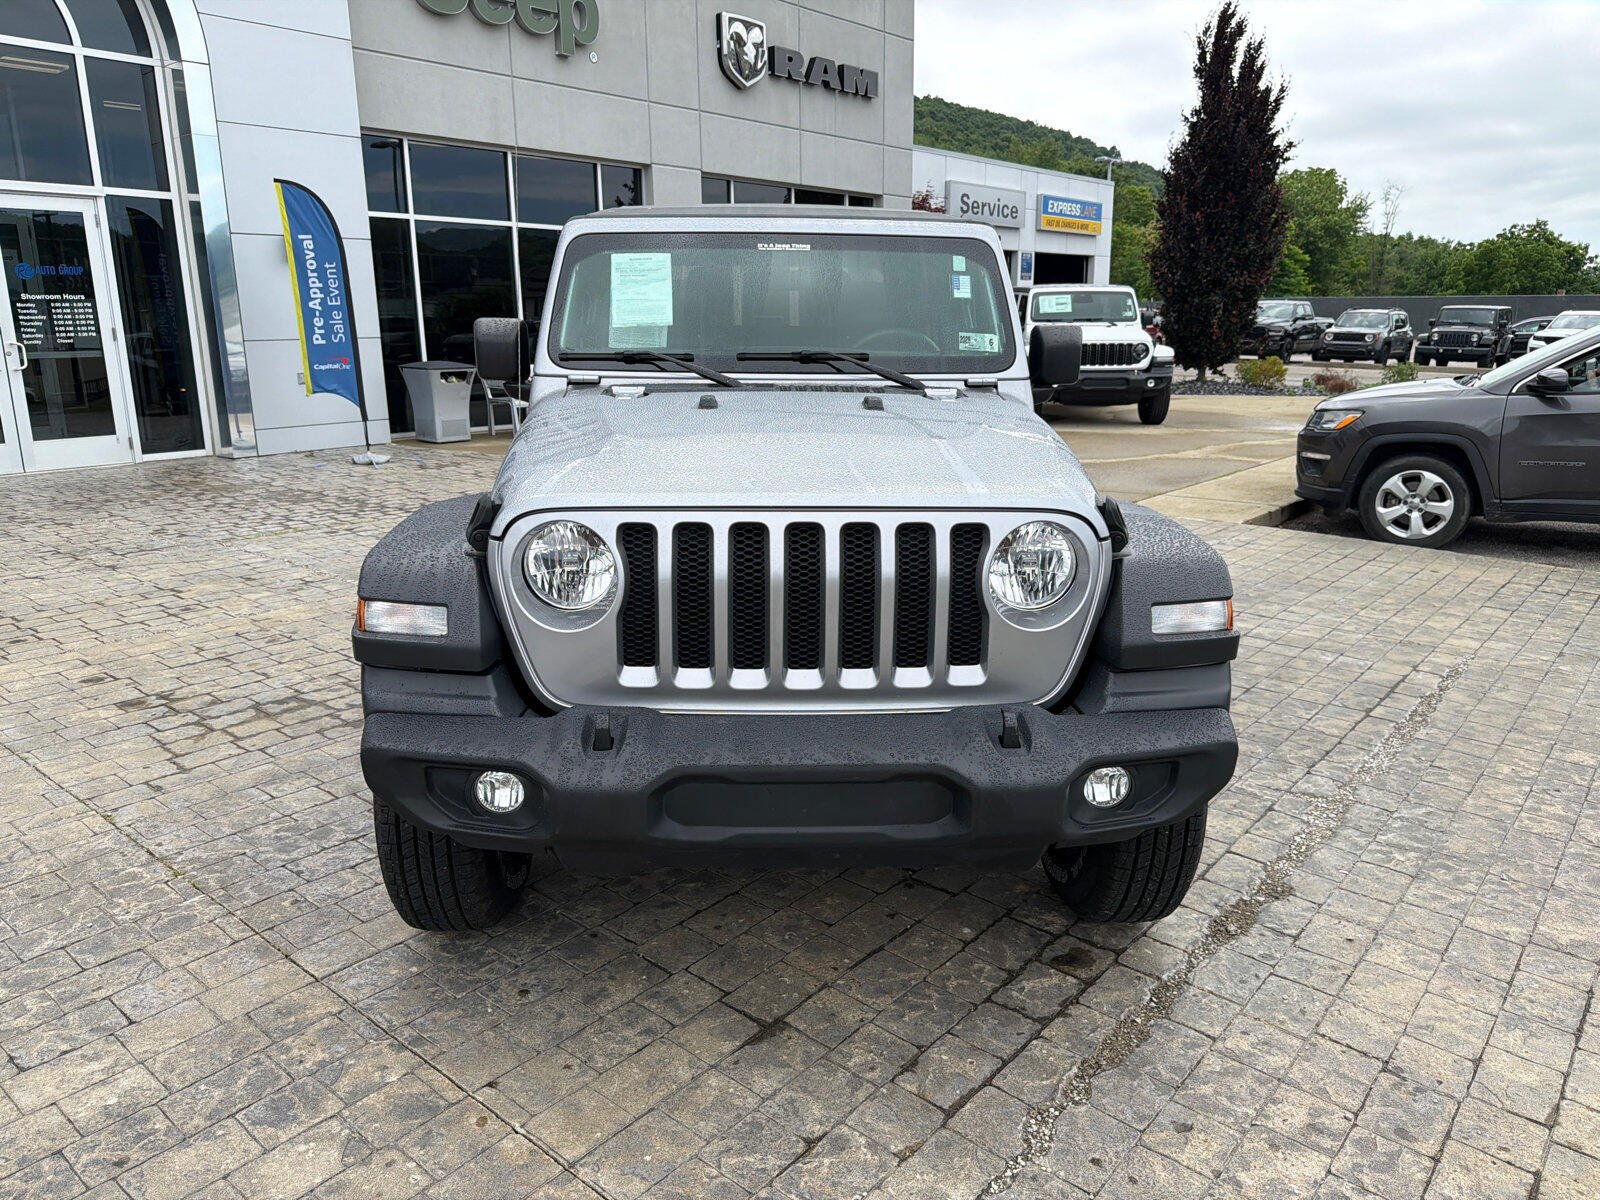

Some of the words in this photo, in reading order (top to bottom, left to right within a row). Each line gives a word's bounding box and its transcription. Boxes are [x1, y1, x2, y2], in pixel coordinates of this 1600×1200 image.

[415, 0, 600, 57] ep
[768, 45, 878, 98] RAM
[960, 193, 1019, 219] Service
[1048, 200, 1081, 216] EXPRESS
[35, 265, 56, 275] AUTO
[324, 261, 340, 306] Event
[298, 234, 326, 345] Pre-Approval
[329, 310, 345, 342] Sale
